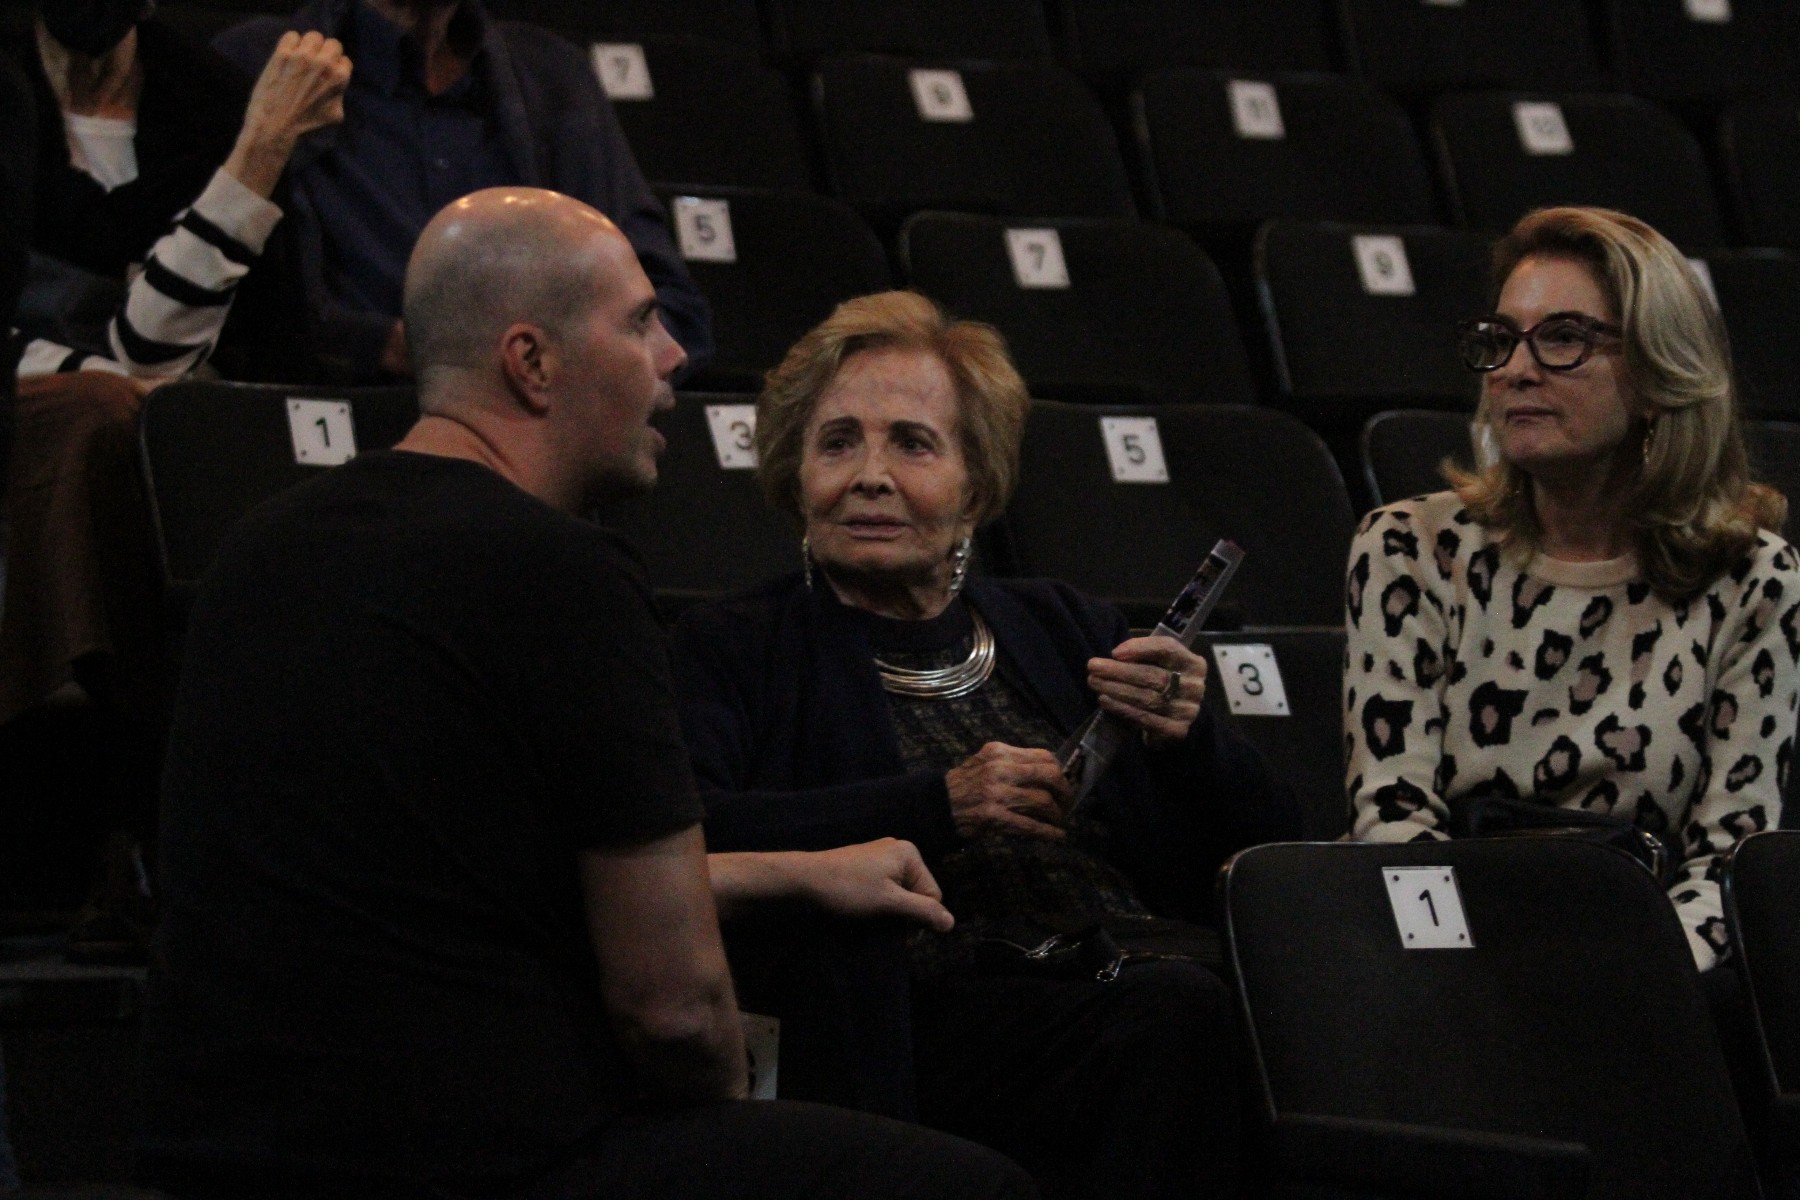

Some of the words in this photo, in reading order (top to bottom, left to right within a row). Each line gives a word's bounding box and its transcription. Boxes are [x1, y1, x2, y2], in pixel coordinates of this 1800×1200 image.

[692, 213, 717, 244] 5
[1026, 241, 1047, 272] 7
[314, 416, 332, 449] 1
[730, 420, 754, 451] 3
[1122, 434, 1147, 466] 5
[1237, 662, 1264, 697] 3
[1418, 889, 1440, 928] 1
